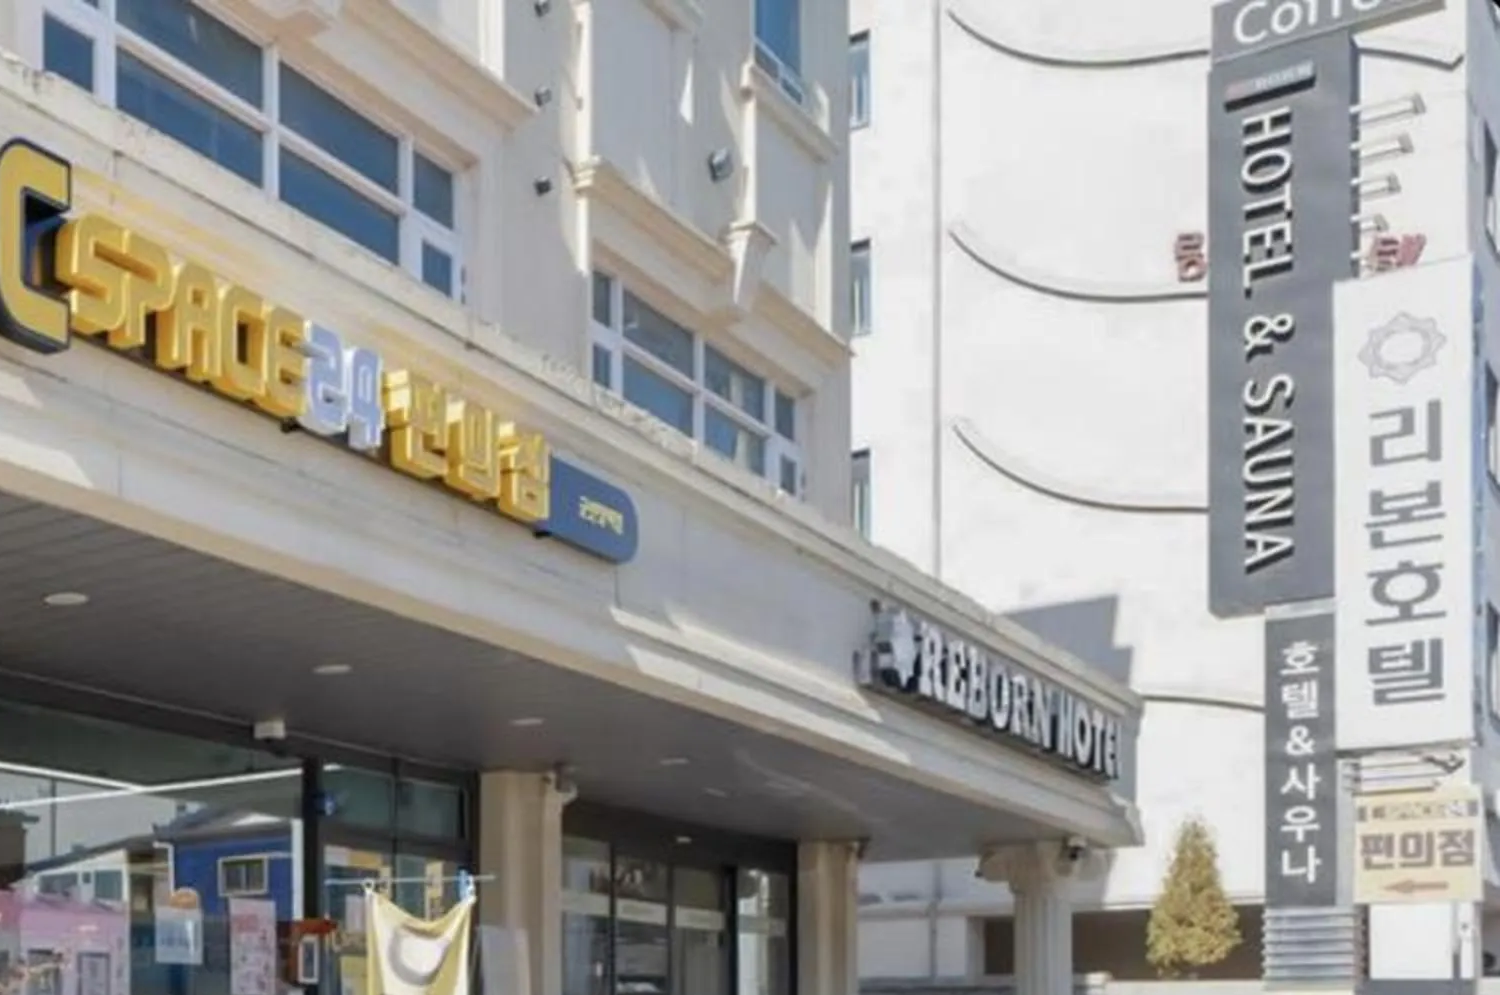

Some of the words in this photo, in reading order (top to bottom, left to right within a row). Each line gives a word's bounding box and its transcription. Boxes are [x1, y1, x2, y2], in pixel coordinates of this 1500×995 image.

[1240, 105, 1293, 297] HOTEL
[1243, 312, 1295, 362] &
[384, 368, 550, 522] 편의점
[1243, 373, 1295, 575] SAUNA
[1363, 399, 1447, 706] 리본호텔
[917, 620, 1052, 750] REBORN
[1280, 640, 1322, 883] 호텔&사우나
[1361, 829, 1475, 871] 편의점
